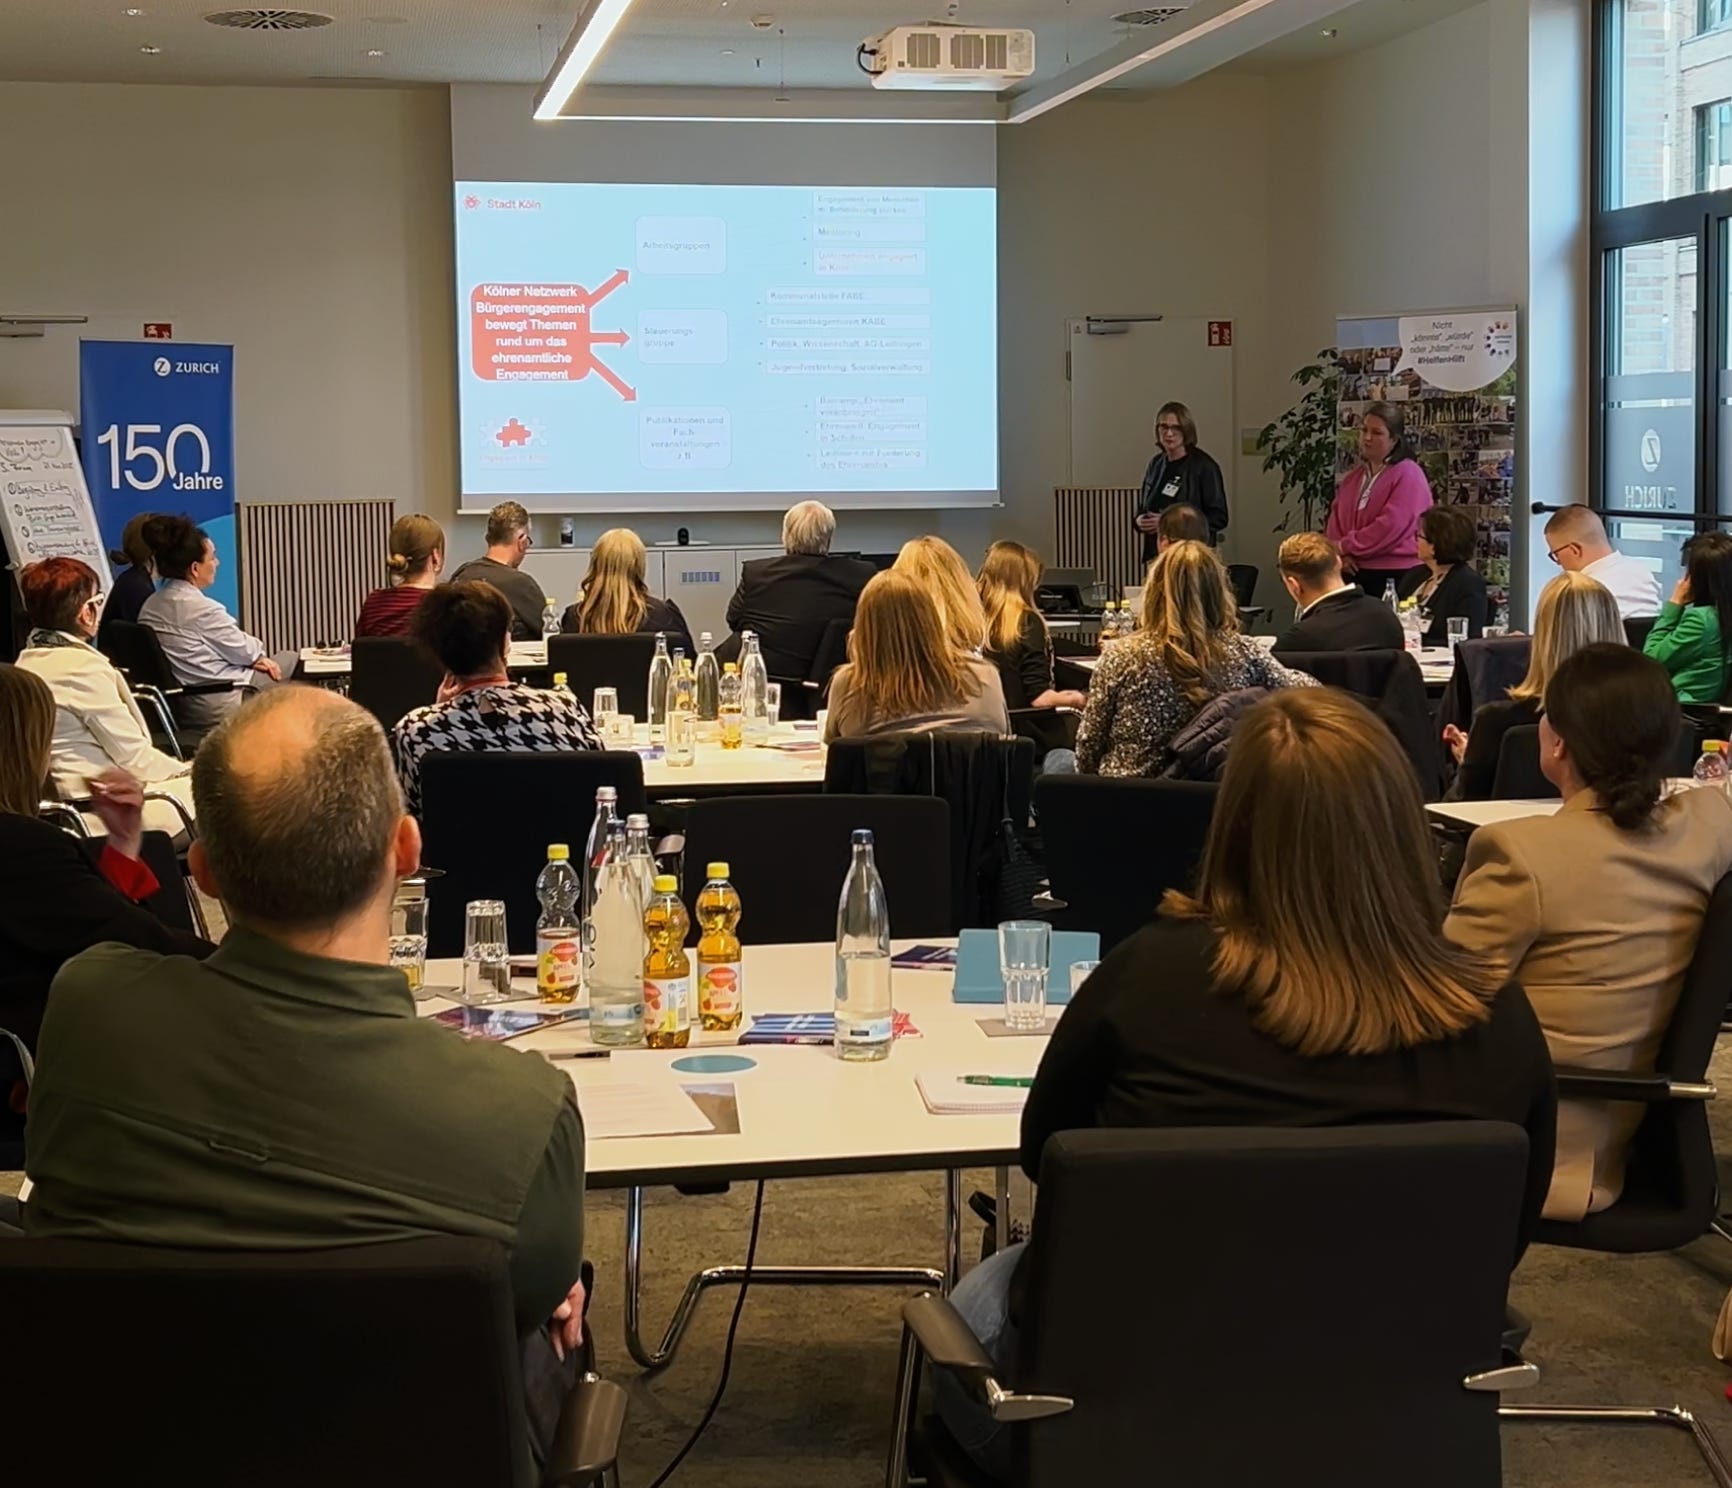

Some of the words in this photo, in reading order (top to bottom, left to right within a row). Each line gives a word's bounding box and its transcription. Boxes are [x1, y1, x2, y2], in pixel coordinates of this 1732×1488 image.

[487, 198, 516, 210] Stadt
[518, 197, 542, 210] Köln
[642, 241, 711, 251] Arbeitsgruppen
[483, 285, 520, 297] Kölner
[523, 285, 578, 297] Netzwerk
[476, 301, 586, 316] Bürgerengagement
[485, 319, 528, 332] bewegt
[529, 319, 577, 331] Themen
[1432, 321, 1453, 329] Nicht
[495, 336, 522, 347] rund
[525, 338, 543, 347] um
[546, 336, 567, 347] das
[1409, 345, 1427, 353] oder
[491, 353, 572, 363] ehrenamtliche
[1417, 355, 1466, 365] #HelfenHilft
[175, 362, 220, 374] ZURICH
[496, 368, 569, 382] Engagement
[97, 423, 211, 490] 150
[172, 472, 223, 490] Jahre
